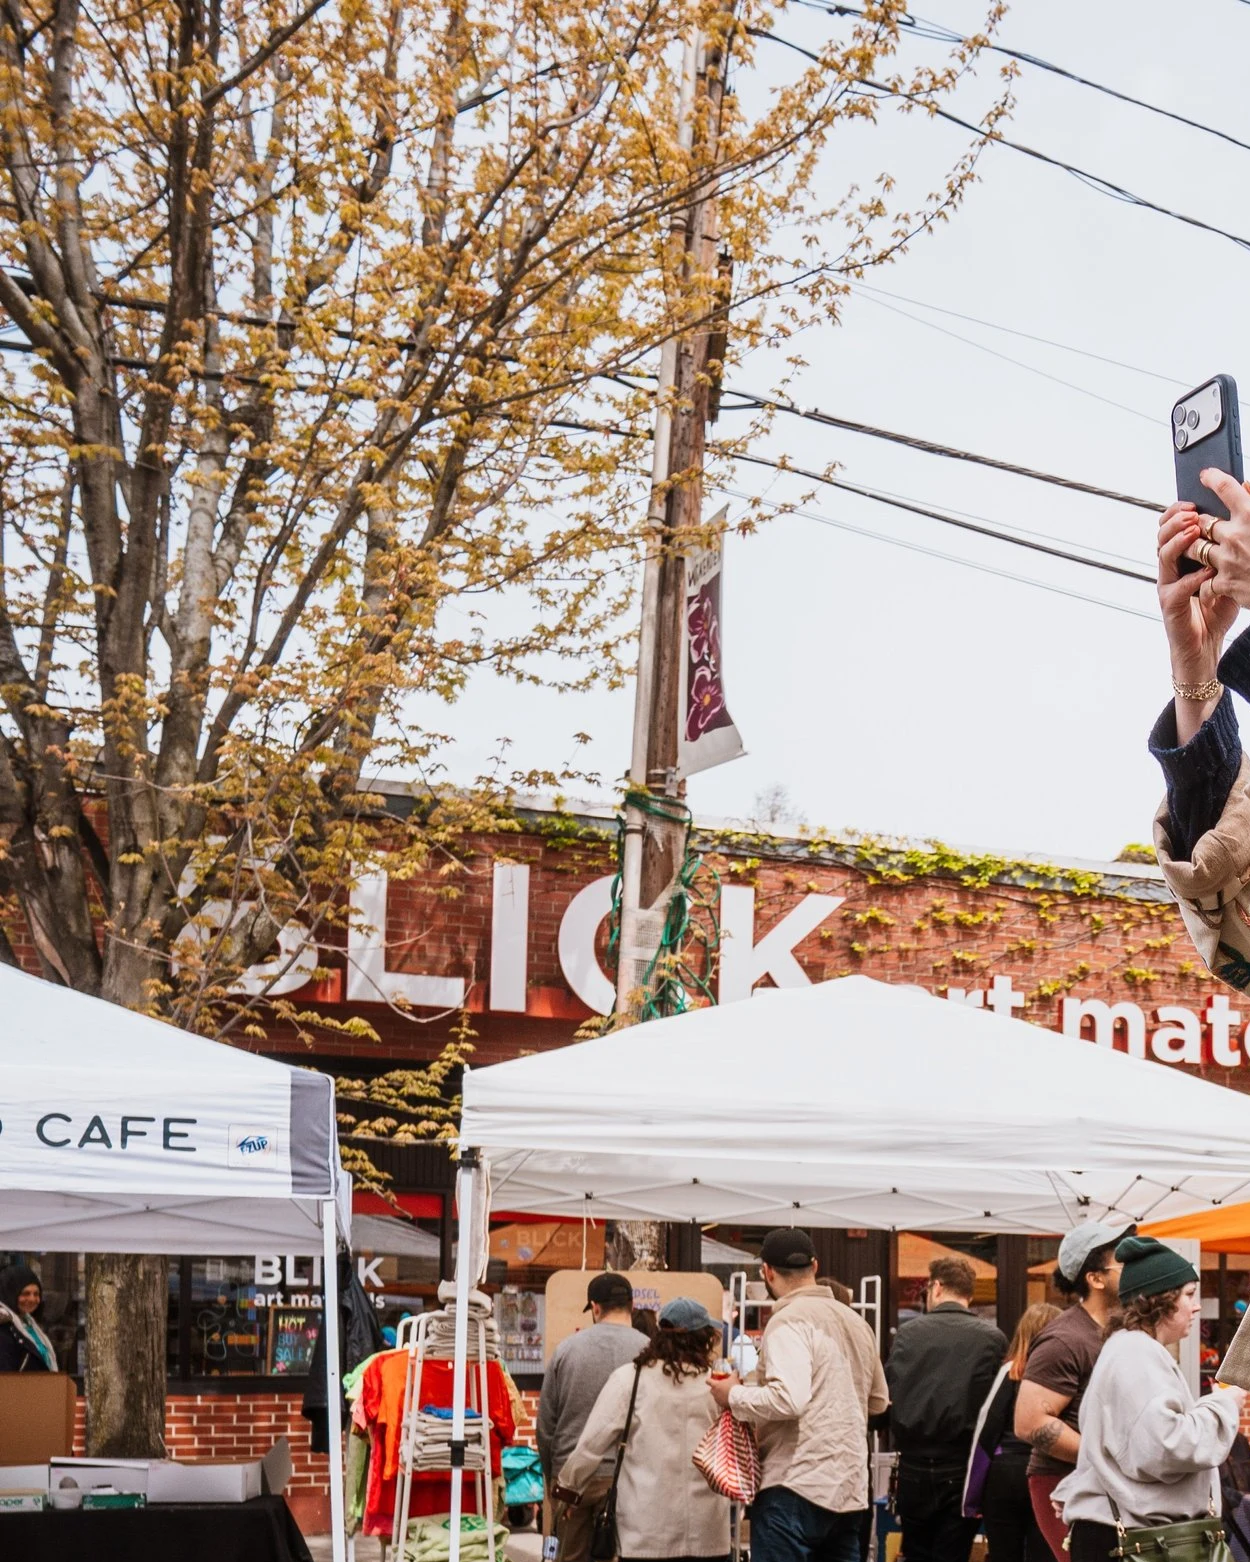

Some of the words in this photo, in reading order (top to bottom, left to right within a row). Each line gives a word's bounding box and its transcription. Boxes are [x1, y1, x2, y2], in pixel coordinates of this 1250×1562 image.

[36, 1112, 197, 1152] CAFE
[254, 1255, 384, 1288] BLIK
[254, 1291, 284, 1307] art
[278, 1314, 306, 1331] HOT
